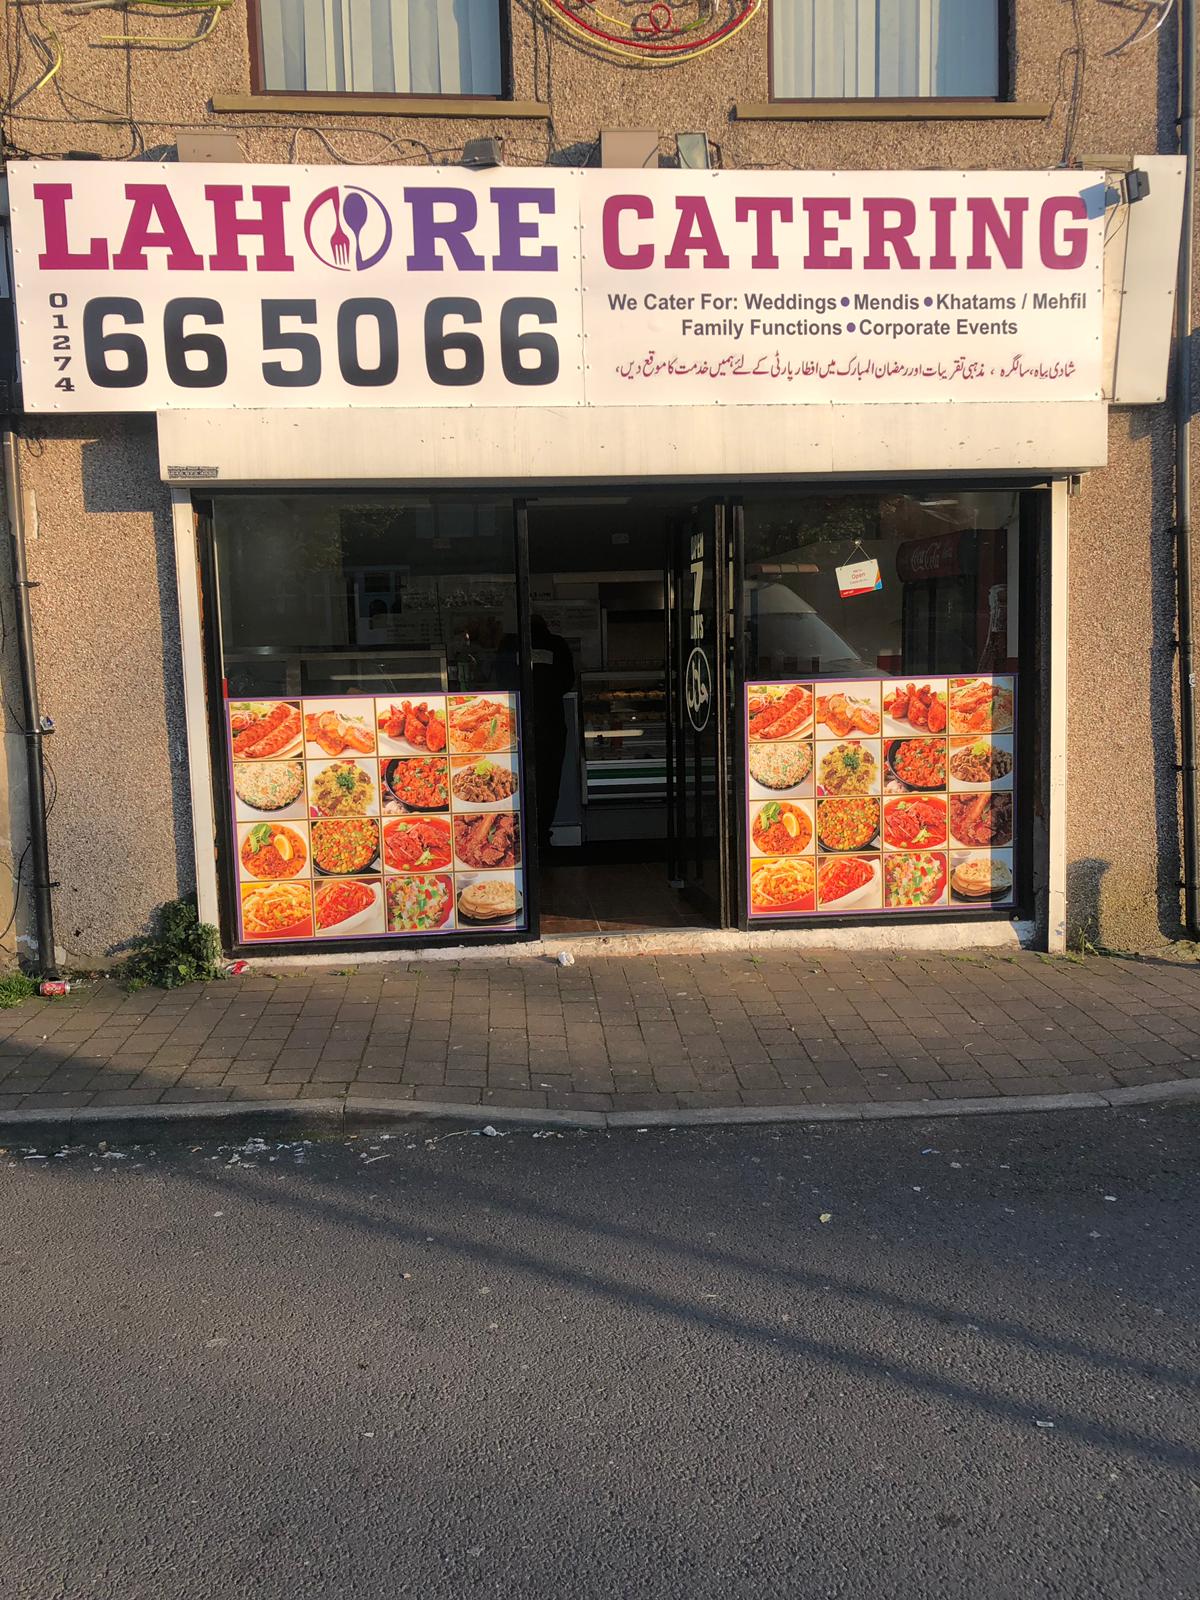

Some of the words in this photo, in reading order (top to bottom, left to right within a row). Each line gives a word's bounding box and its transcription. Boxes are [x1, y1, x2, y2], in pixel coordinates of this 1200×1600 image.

[33, 183, 559, 272] LAHORE
[602, 193, 1088, 270] CATERING
[607, 293, 638, 310] We
[643, 293, 695, 310] Cater
[700, 293, 738, 310] For:
[743, 293, 837, 314] Weddings
[854, 293, 920, 310] Mendis
[936, 293, 1016, 310] Khatams
[1033, 292, 1087, 310] Mehfil
[682, 318, 744, 339] Family
[750, 318, 843, 336] Functions
[859, 318, 951, 340] Corporate
[956, 318, 1018, 335] Events
[690, 561, 704, 611] 7
